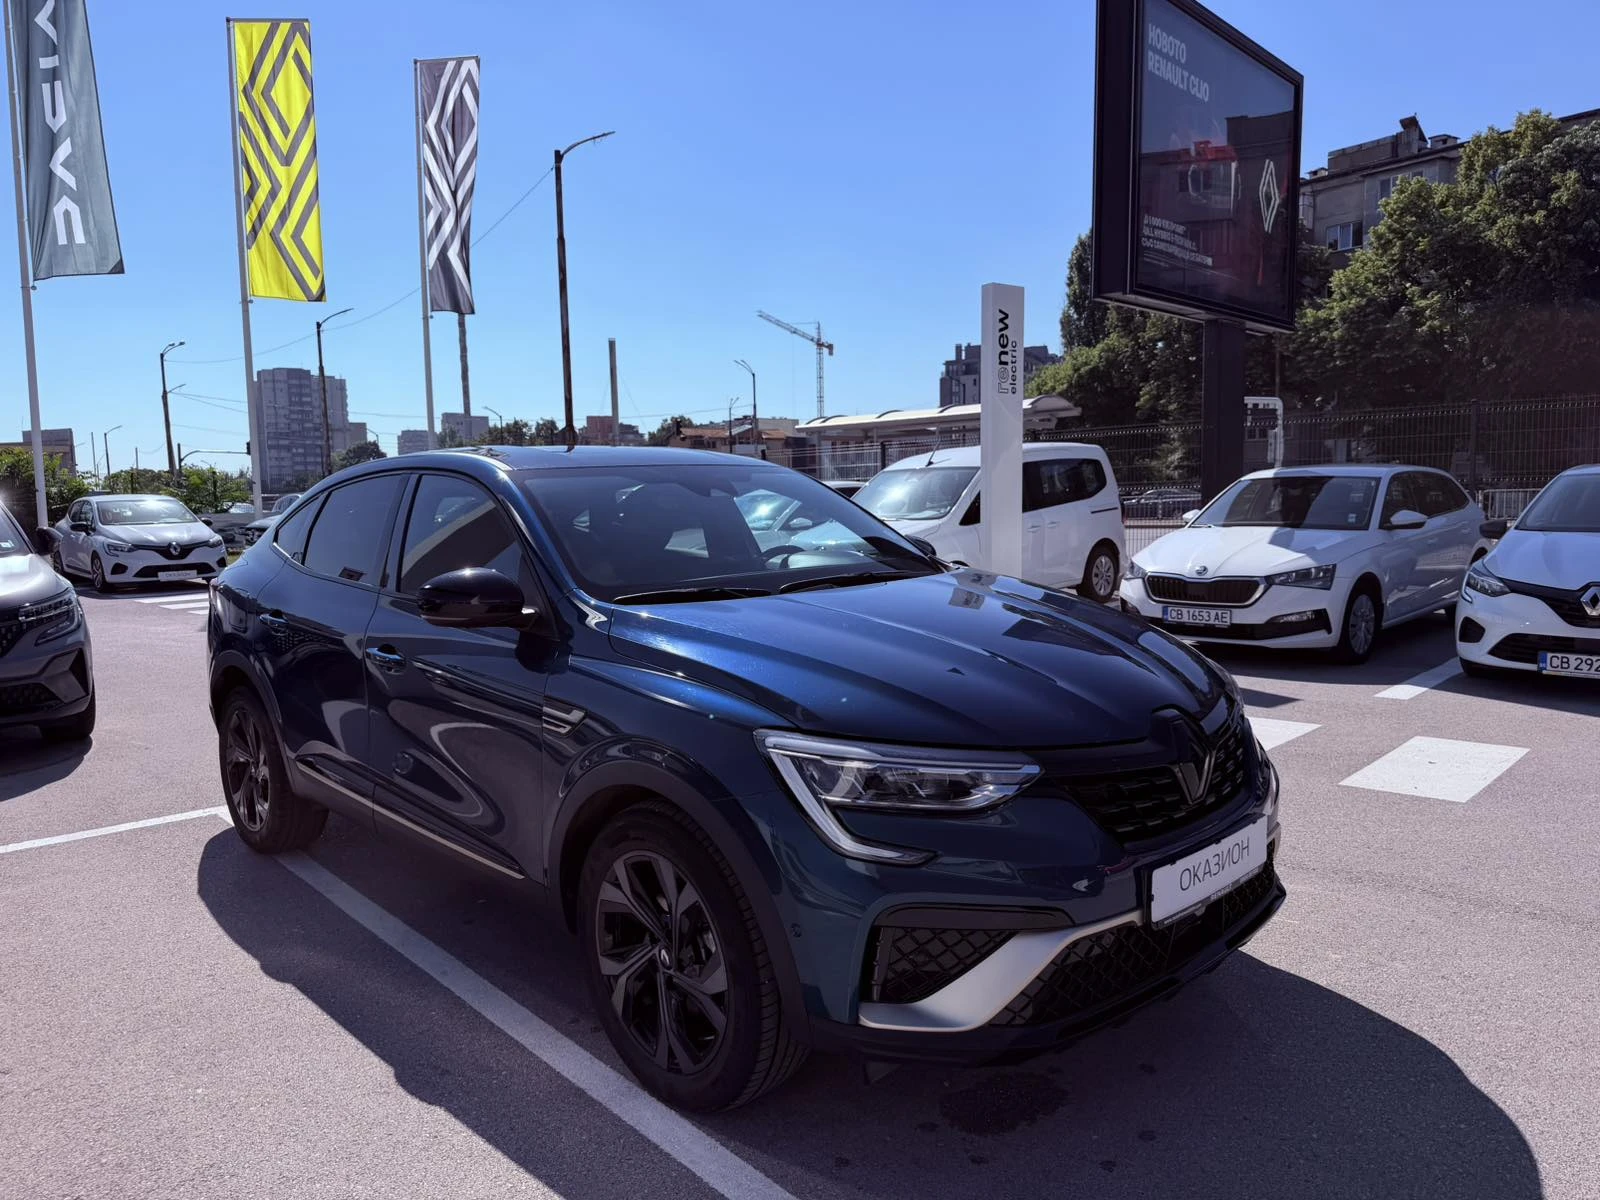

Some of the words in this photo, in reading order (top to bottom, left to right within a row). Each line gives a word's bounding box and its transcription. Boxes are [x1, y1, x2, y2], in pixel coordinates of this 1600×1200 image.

[1147, 49, 1189, 91] RENAULT
[1189, 74, 1209, 102] CLIO
[998, 308, 1009, 395] renew
[1009, 340, 1017, 394] electric
[1186, 610, 1211, 622] 1653
[1179, 836, 1250, 891] ОКАЗИОН
